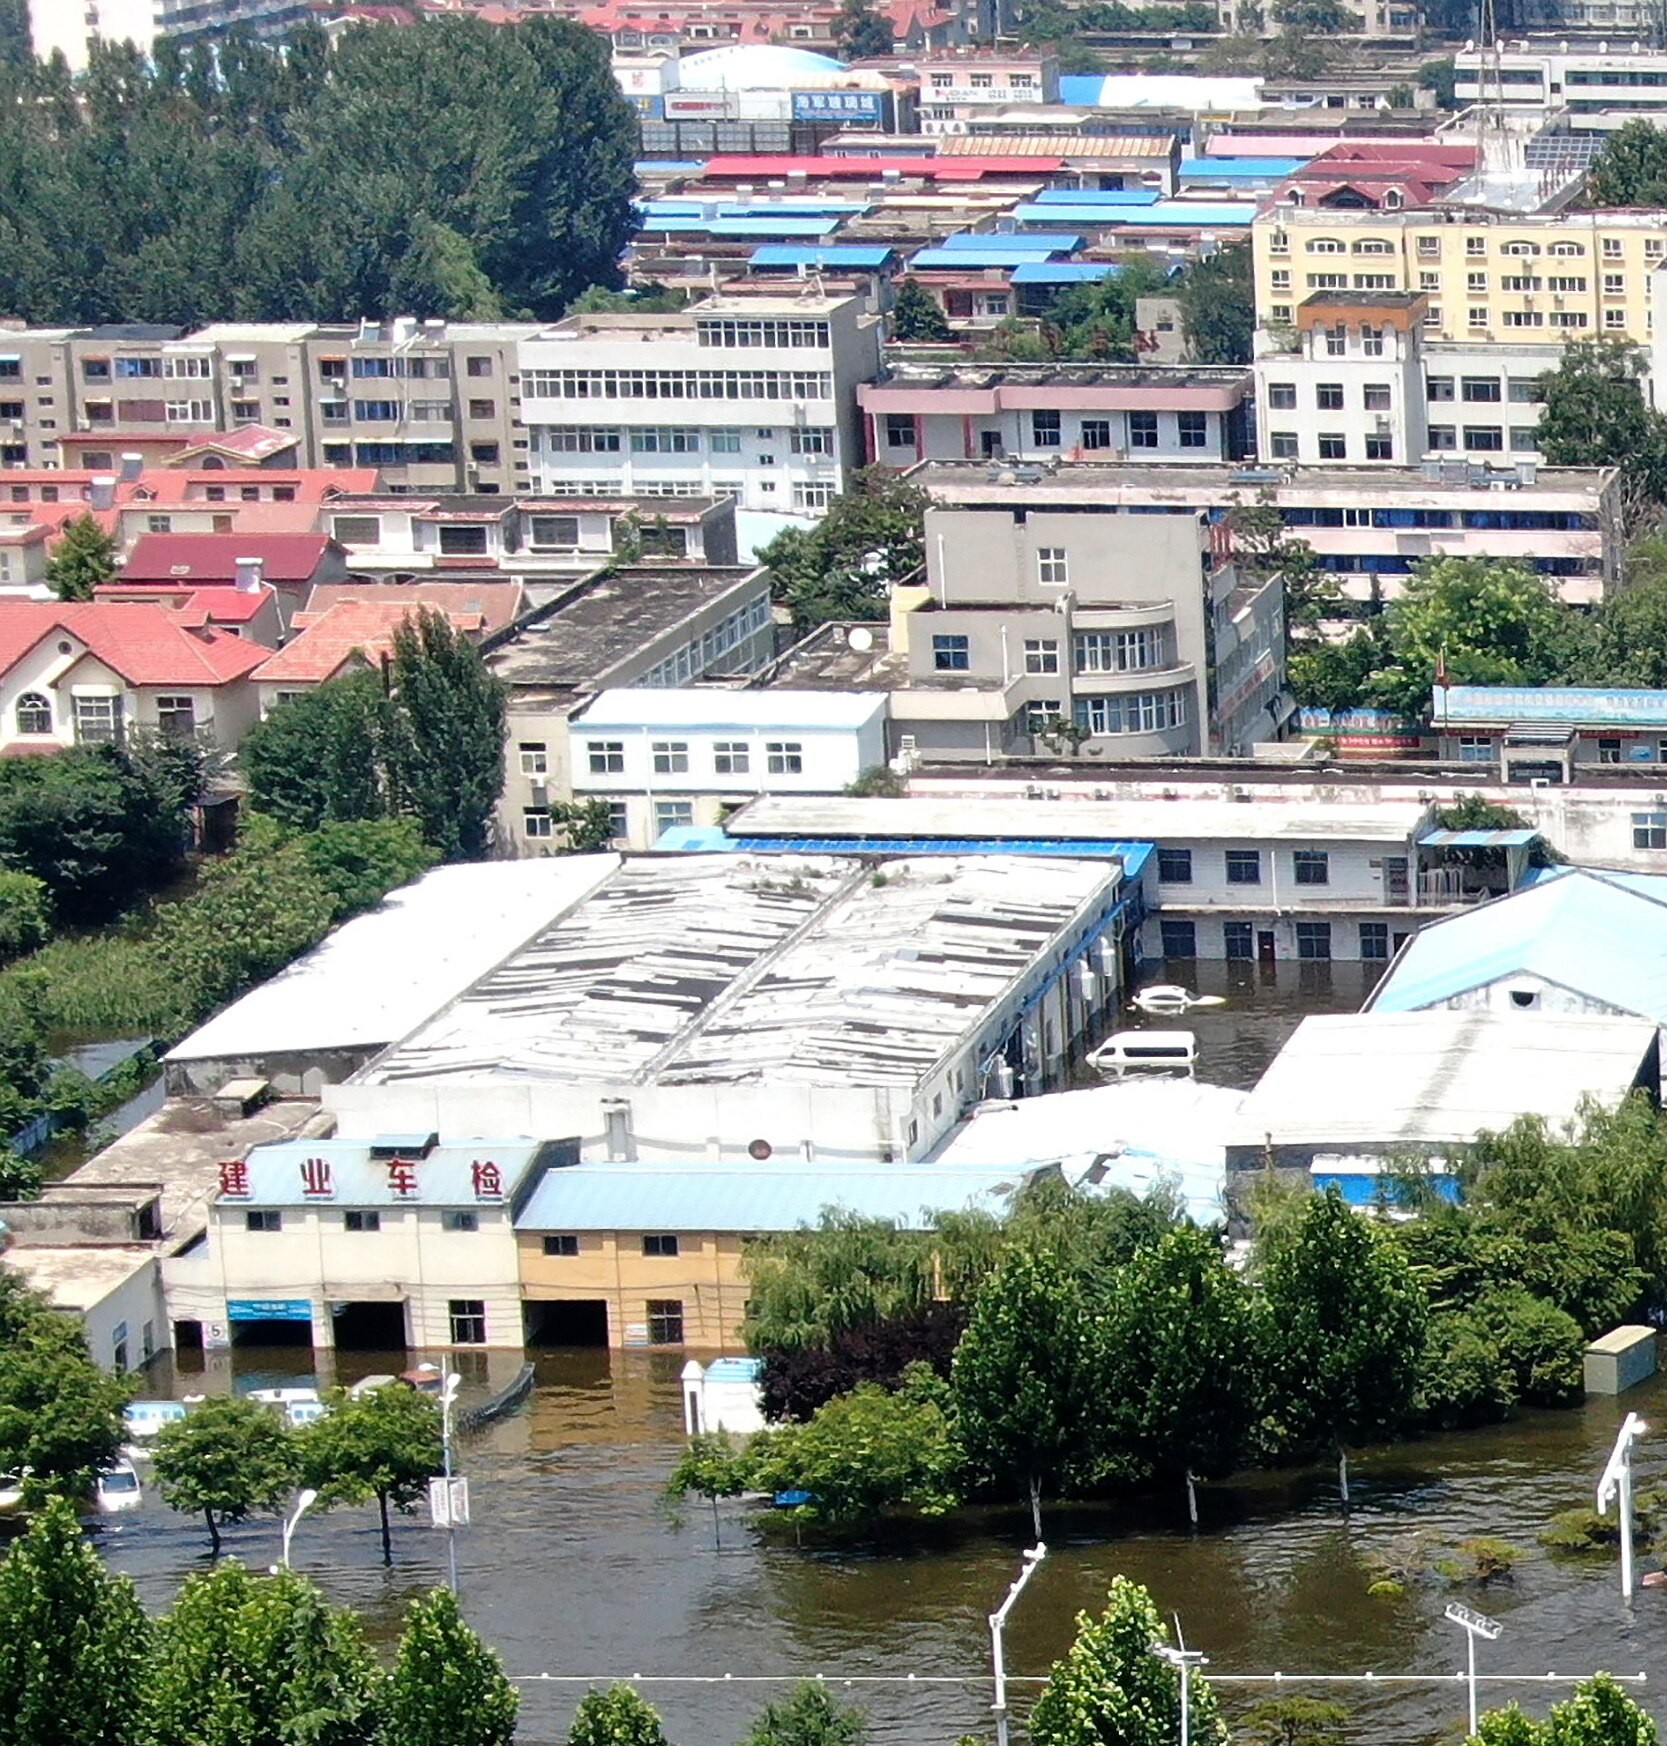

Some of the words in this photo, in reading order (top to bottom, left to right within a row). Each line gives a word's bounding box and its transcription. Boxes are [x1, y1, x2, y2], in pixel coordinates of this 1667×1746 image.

[218, 1157, 503, 1197] 建业车检
[211, 1324, 220, 1337] 5
